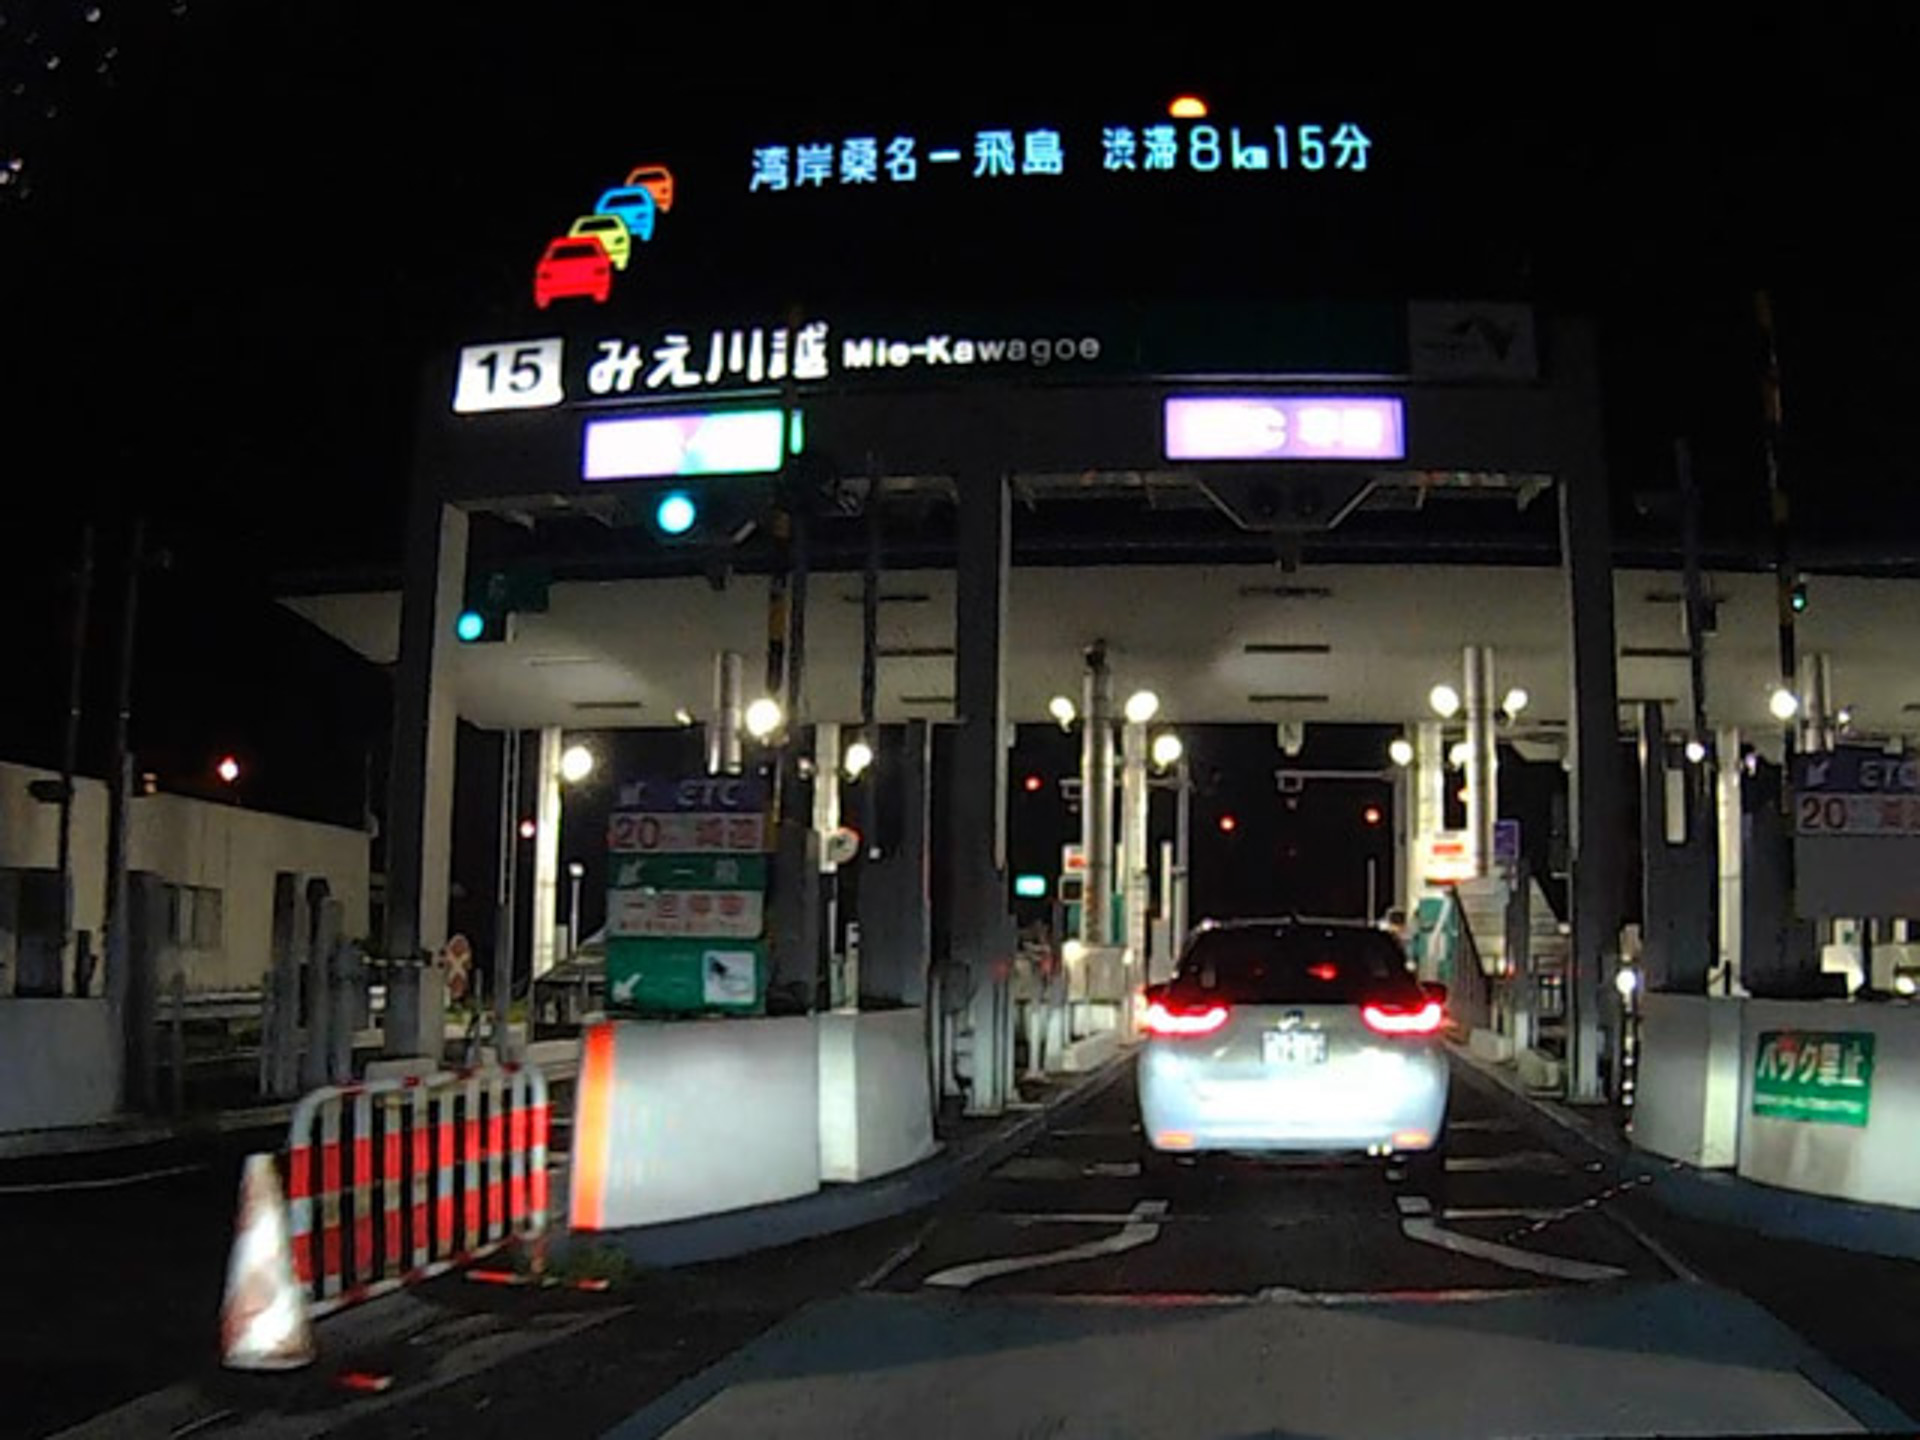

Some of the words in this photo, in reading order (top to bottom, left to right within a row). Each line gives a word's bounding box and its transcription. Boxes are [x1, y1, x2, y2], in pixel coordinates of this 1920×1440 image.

[843, 335, 1100, 370] Mie-Kawagoe
[477, 348, 543, 395] 15
[677, 778, 741, 807] ETC
[1801, 797, 1847, 829] 20
[615, 817, 660, 849] 20
